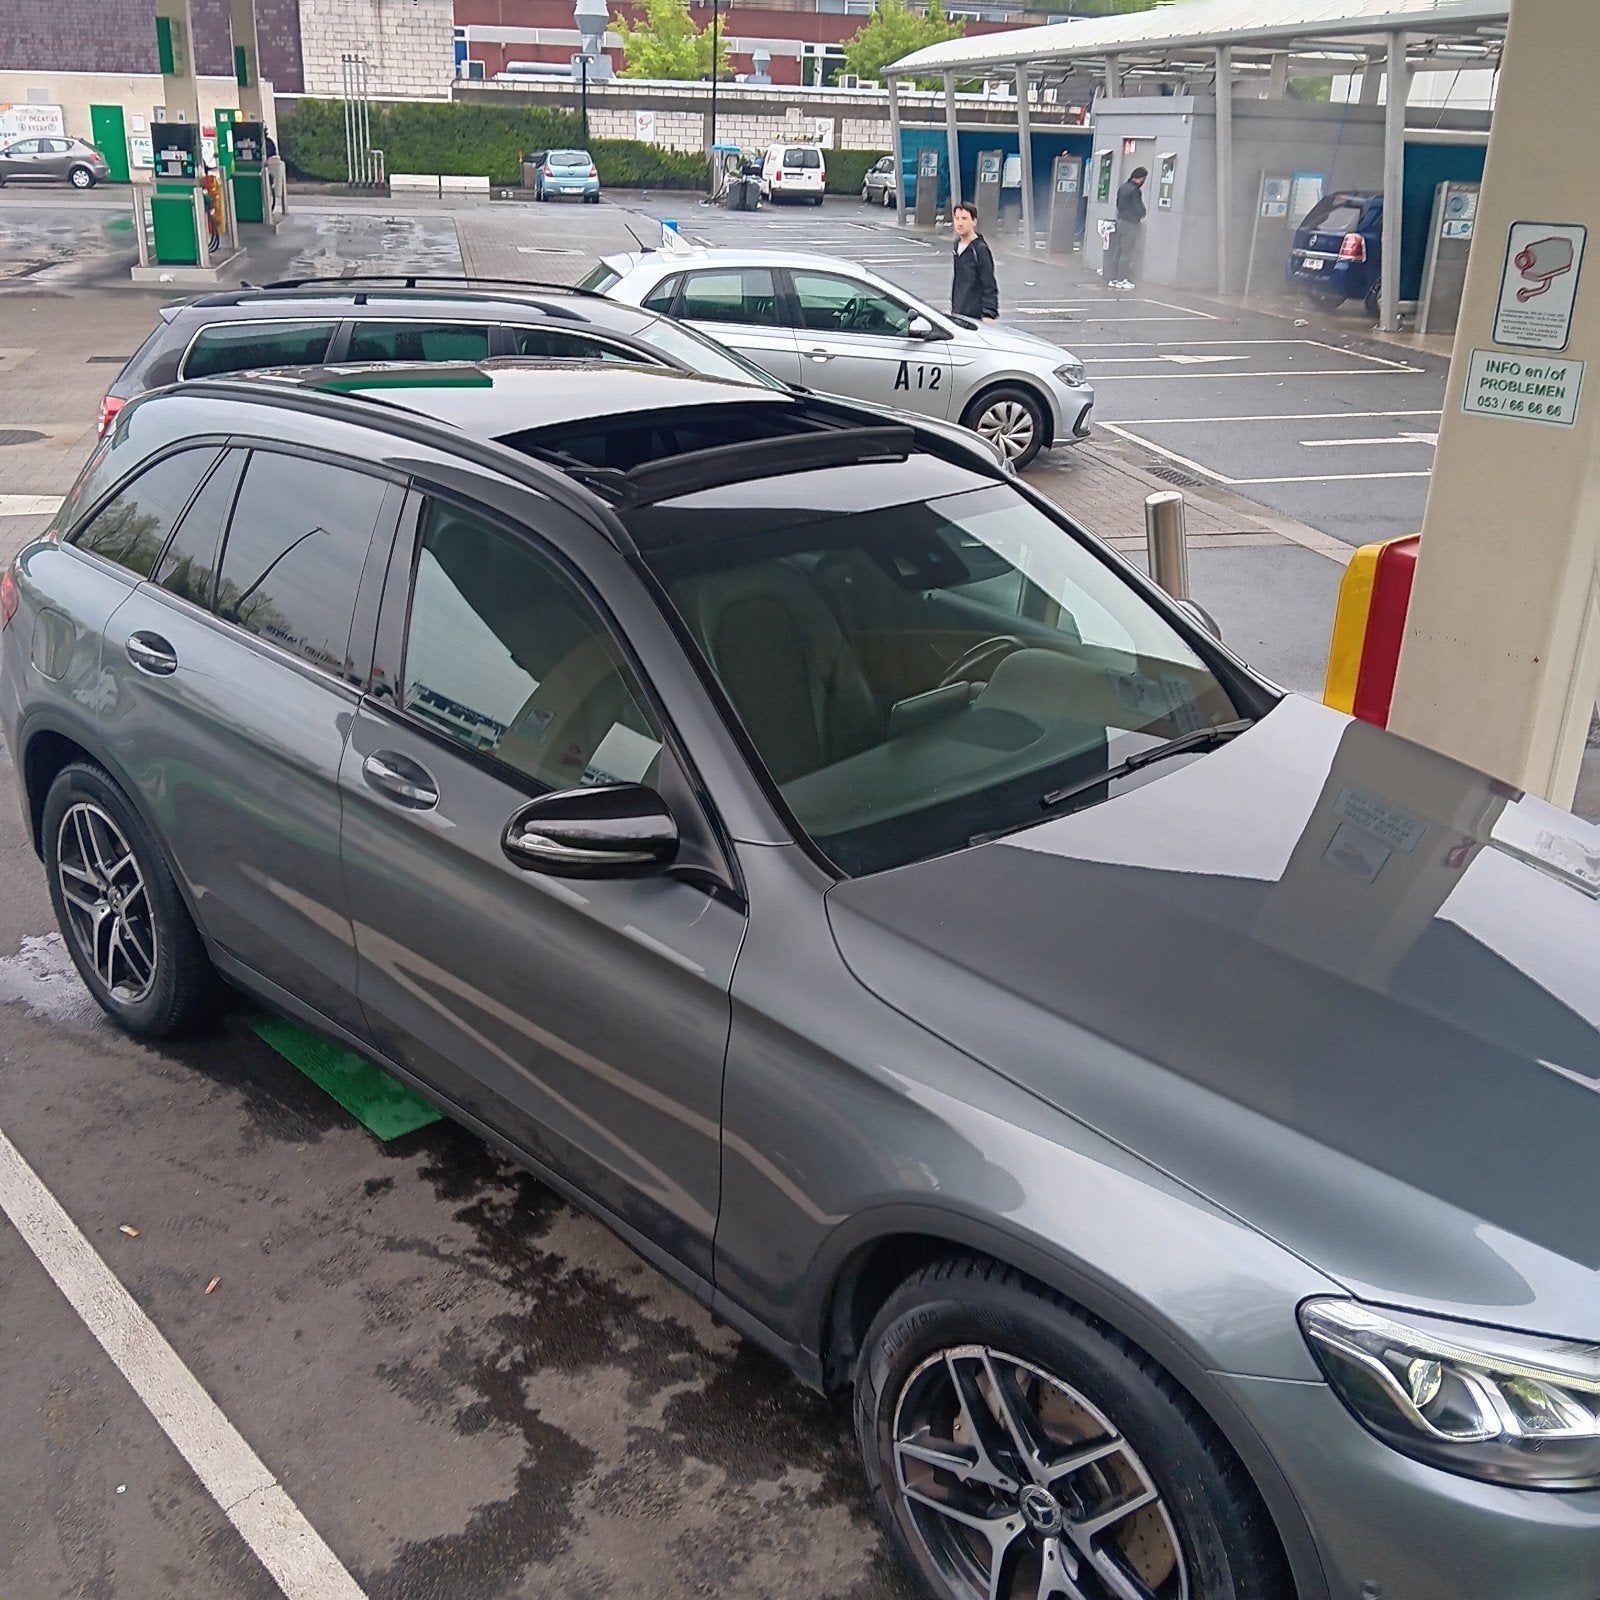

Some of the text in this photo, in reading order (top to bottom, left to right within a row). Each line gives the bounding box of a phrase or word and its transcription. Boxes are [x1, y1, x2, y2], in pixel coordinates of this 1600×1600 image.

[894, 360, 942, 391] A12
[1485, 359, 1521, 376] INFO
[1479, 377, 1566, 398] PROBLEMEN
[1477, 395, 1499, 409] 053
[1509, 400, 1525, 413] 66
[1527, 402, 1543, 415] 66
[1547, 404, 1563, 417] 66
